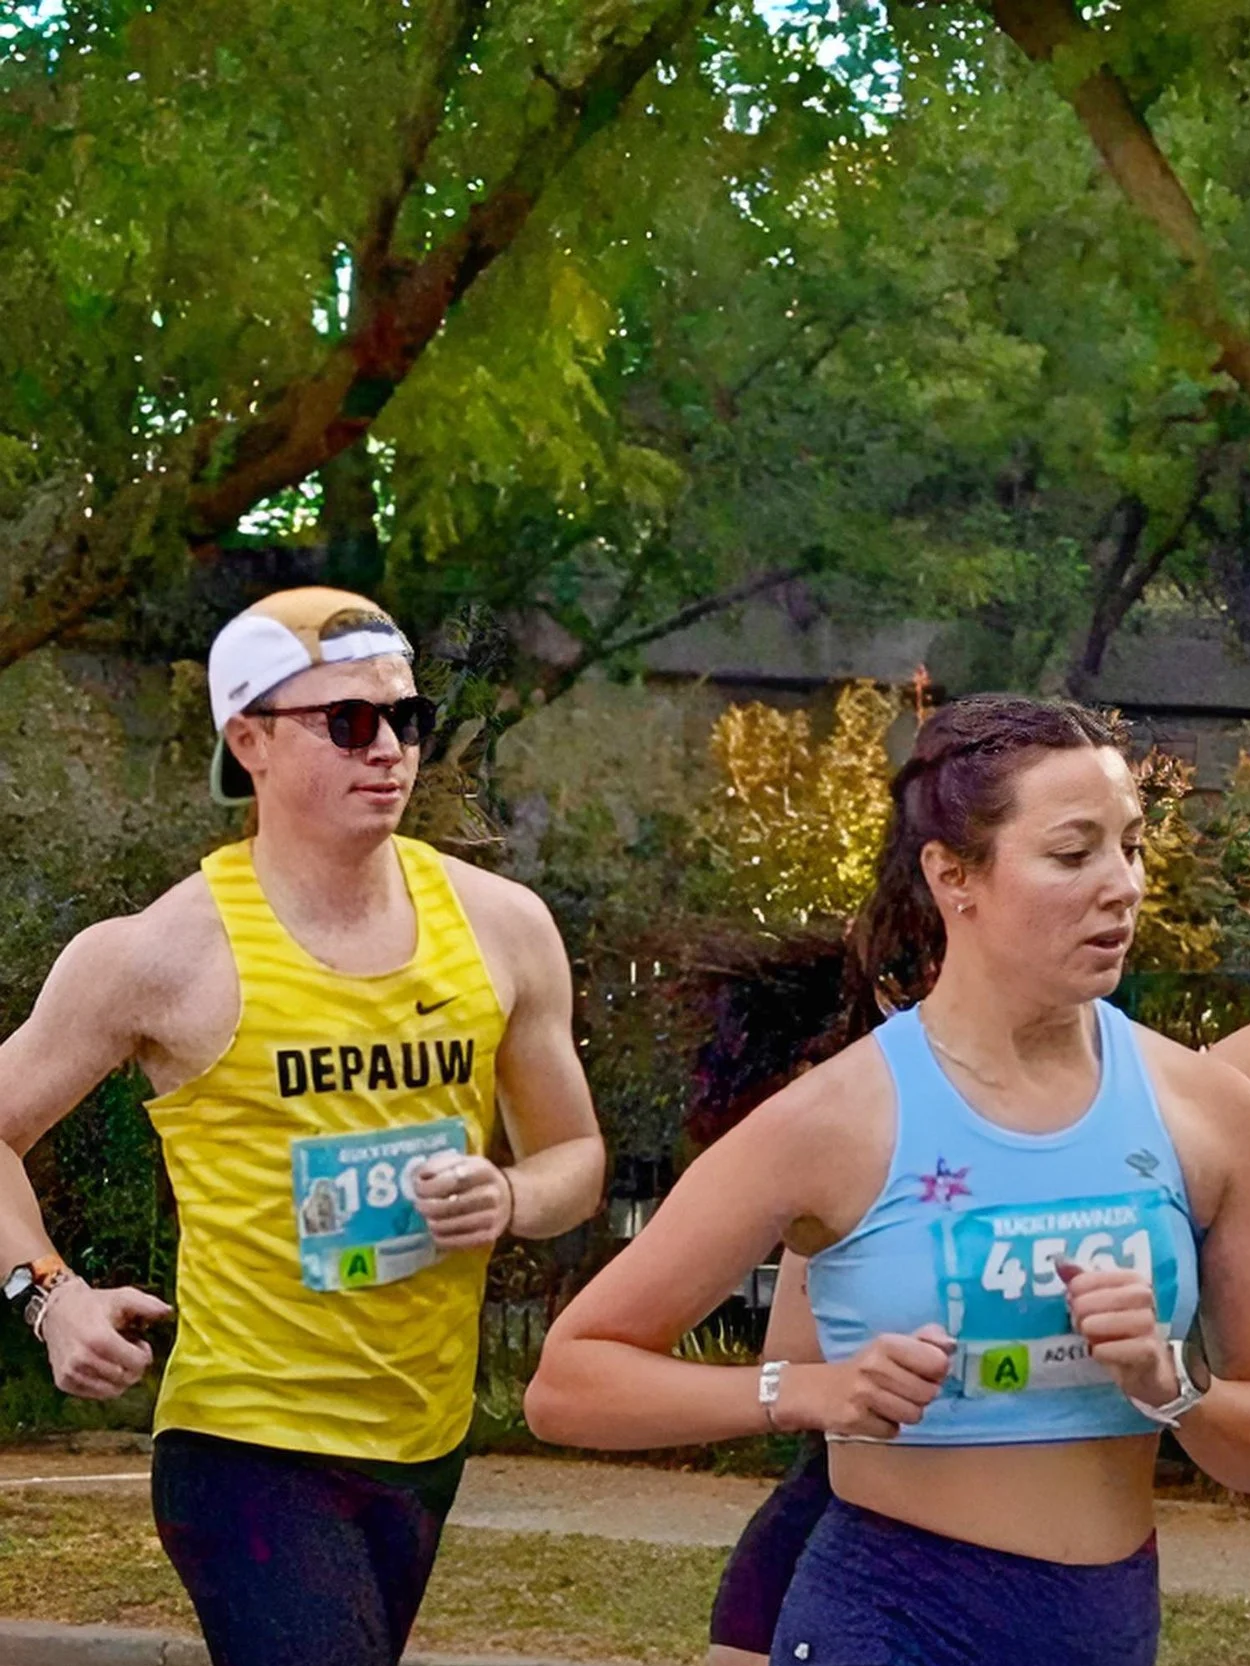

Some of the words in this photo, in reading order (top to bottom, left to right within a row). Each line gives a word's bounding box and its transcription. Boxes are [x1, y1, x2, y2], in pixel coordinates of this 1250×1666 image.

[276, 1038, 475, 1098] DEPAUW
[346, 1254, 369, 1278] A
[994, 1356, 1020, 1384] A
